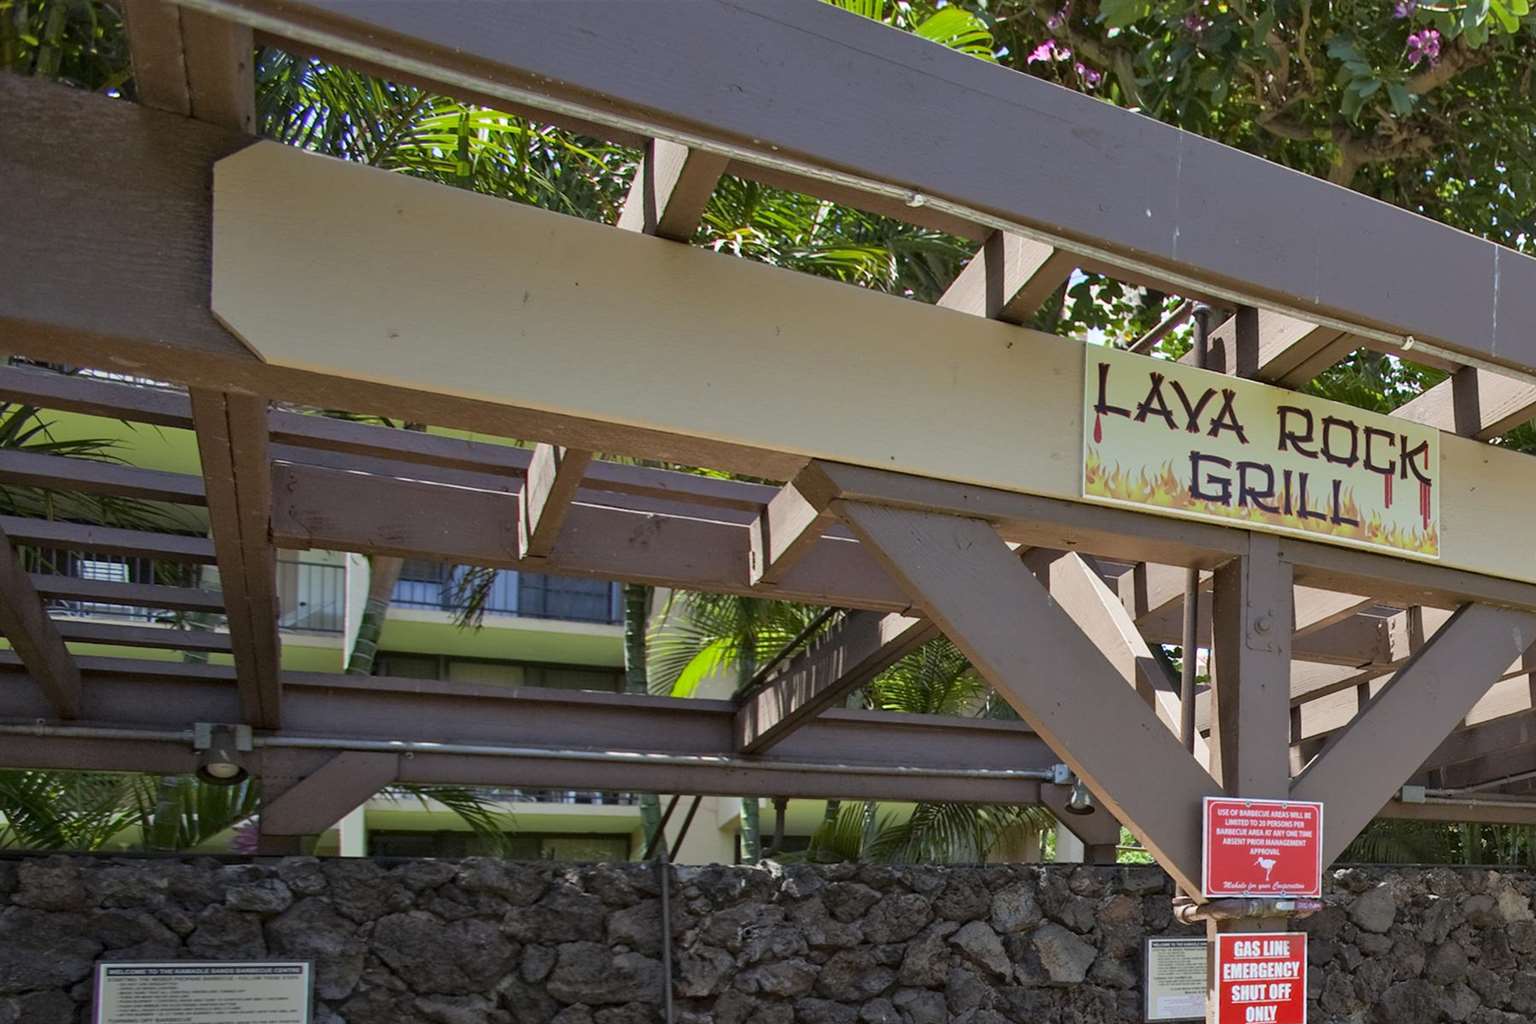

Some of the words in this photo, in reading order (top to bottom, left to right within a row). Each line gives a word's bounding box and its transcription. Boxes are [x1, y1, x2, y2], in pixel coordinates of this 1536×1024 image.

[1093, 362, 1250, 444] LAVA
[1276, 405, 1432, 486] ROCK
[1188, 450, 1360, 527] GRILL
[1234, 940, 1261, 957] GAS
[1263, 940, 1290, 956] LINE
[1223, 962, 1300, 979] EMERGENCY
[1231, 984, 1267, 1001] SHUT
[1269, 983, 1292, 999] OFF
[1245, 1005, 1277, 1022] ONLY
